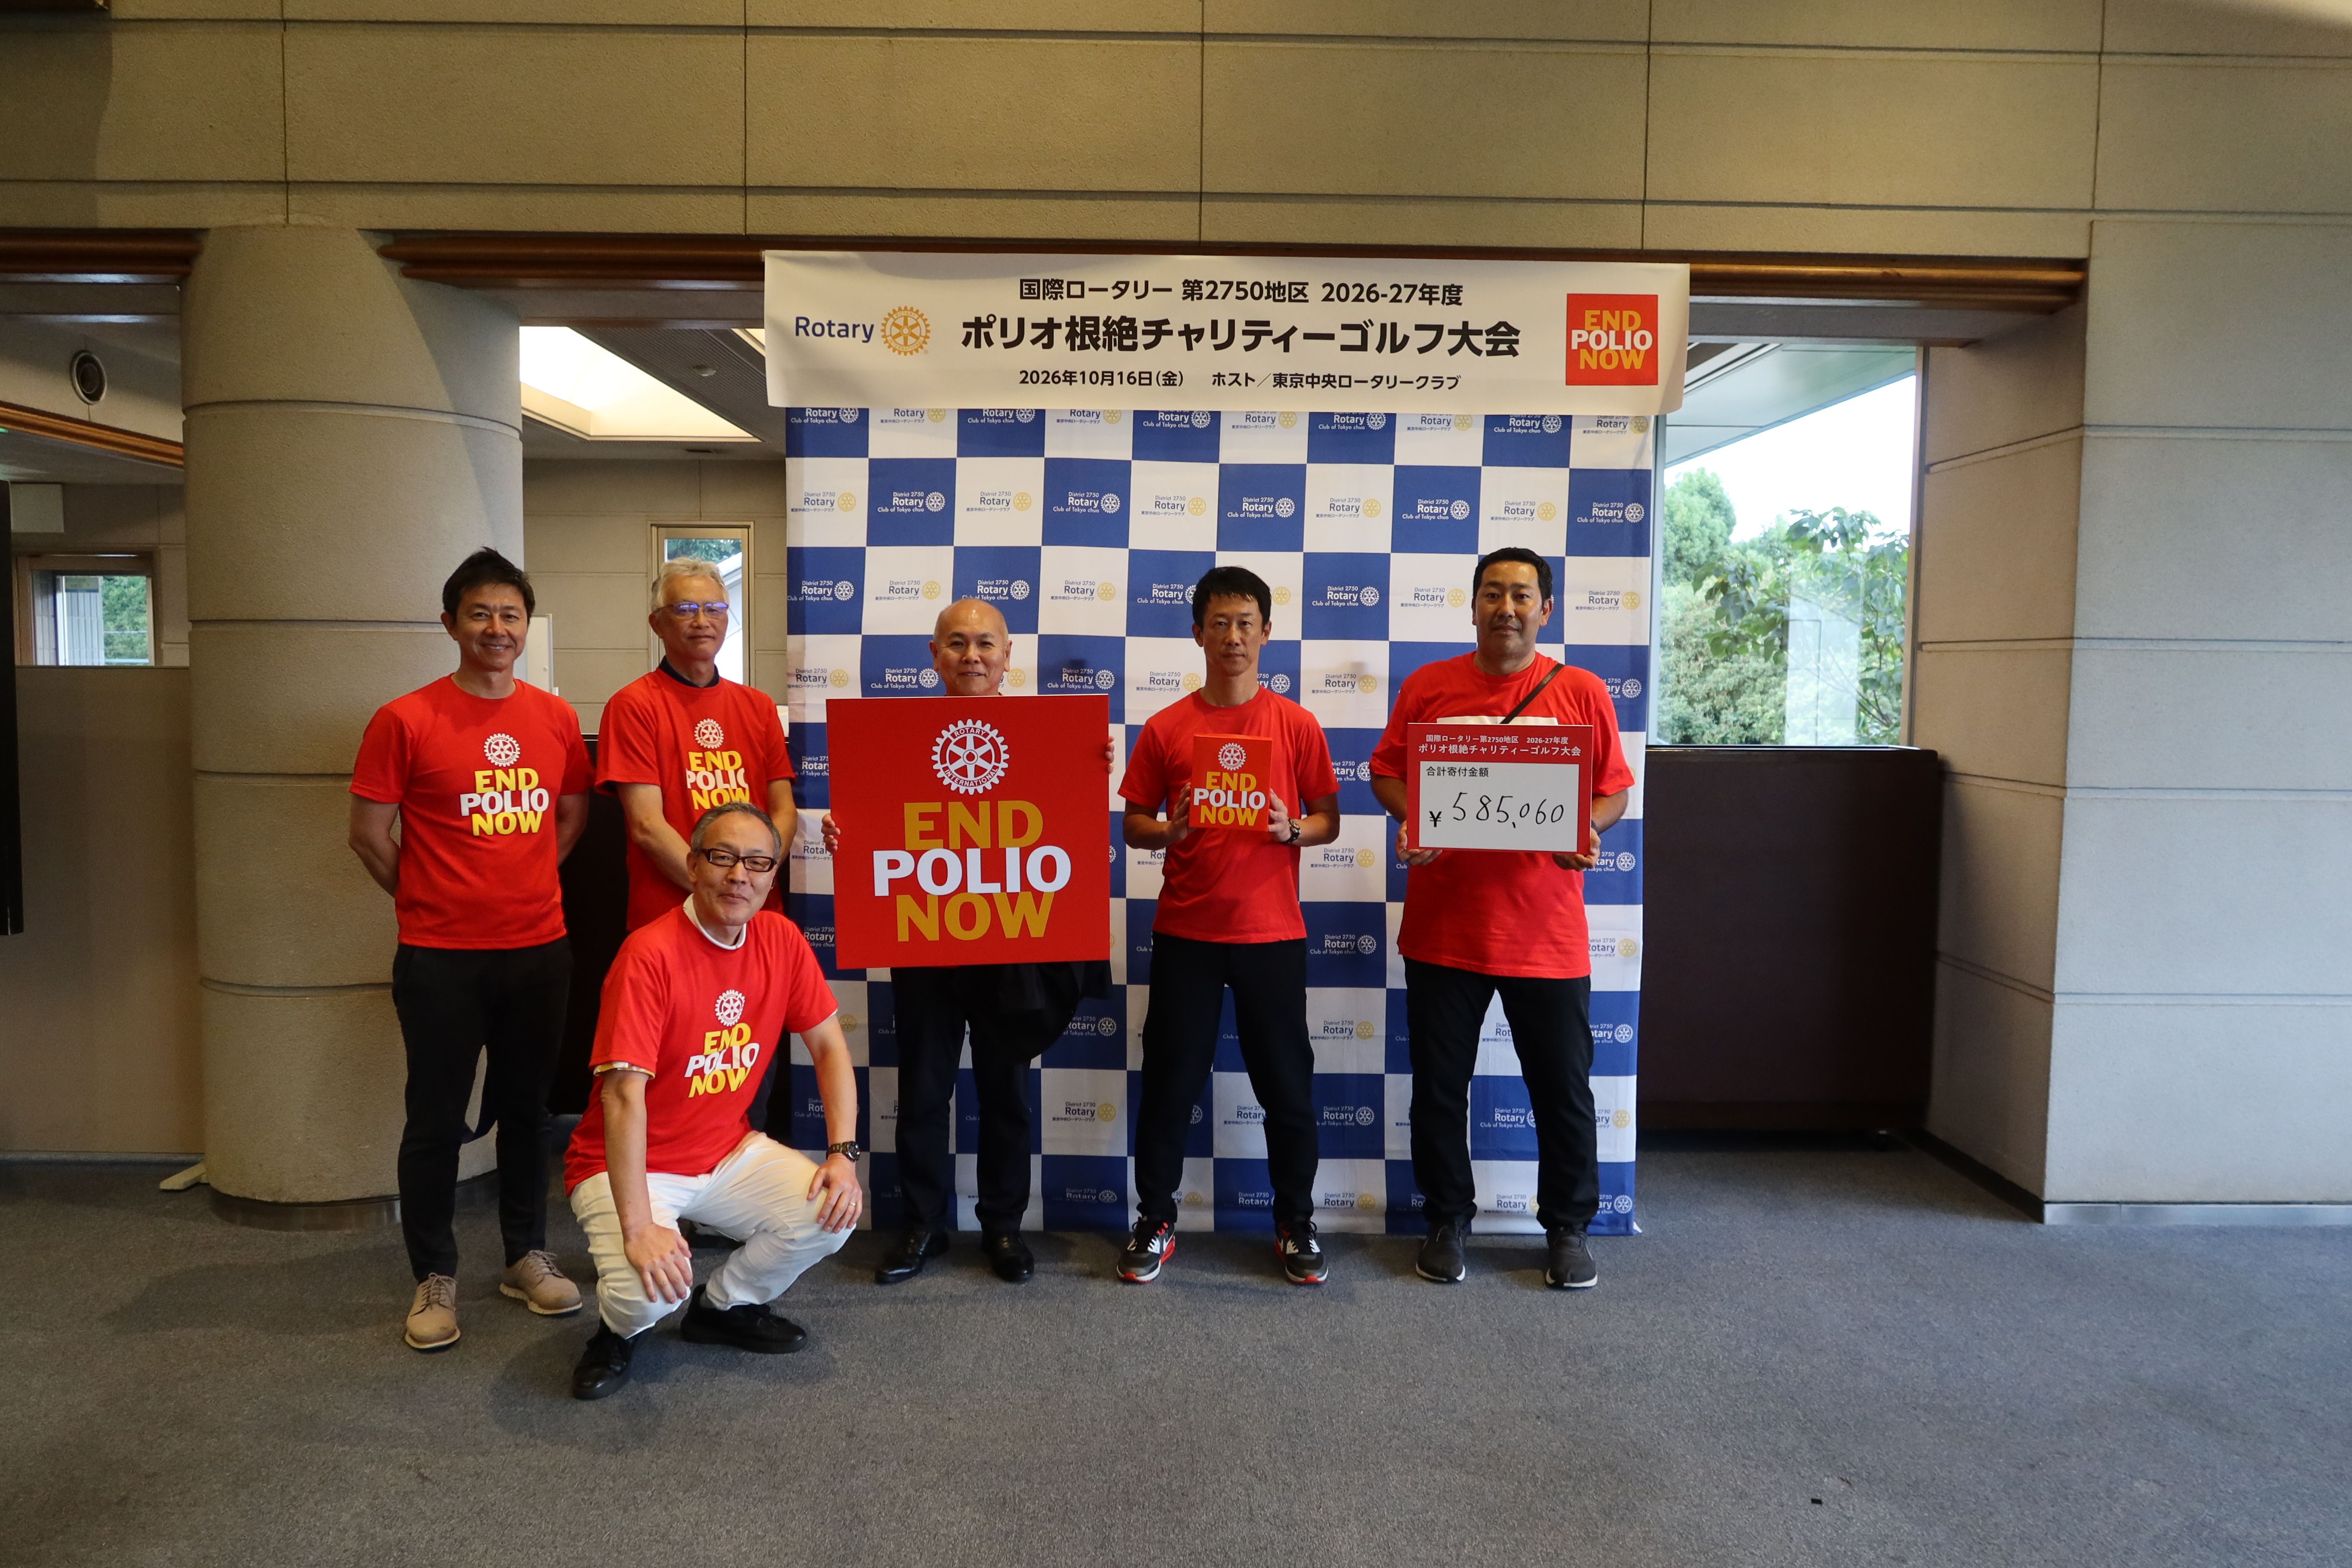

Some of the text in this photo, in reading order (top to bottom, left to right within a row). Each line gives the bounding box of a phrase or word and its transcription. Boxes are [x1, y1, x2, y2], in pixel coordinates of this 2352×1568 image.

[1020, 279, 1464, 306] 国際ロータリー 第2750地区 2026-27年度
[1584, 310, 1642, 331] END
[795, 316, 874, 343] Rotary
[961, 313, 1521, 357] ポリオ根絶チャリティーゴルフ大会
[1571, 329, 1653, 350] POLIO
[1580, 349, 1645, 369] NOW
[894, 408, 924, 418] Rotary
[1158, 413, 1189, 423] Rotary
[1246, 414, 1276, 424] Rotary
[1509, 418, 1540, 428] Rotary
[893, 497, 924, 507] Rotary
[980, 497, 1010, 506] Rotary
[1243, 503, 1274, 513] Rotary
[1329, 503, 1360, 513] Rotary
[1418, 505, 1449, 514] Rotary
[1504, 506, 1534, 516] Rotary
[1592, 508, 1623, 518] Rotary
[889, 586, 919, 595] Rotary
[1152, 589, 1183, 599] Rotary
[1327, 591, 1358, 601] Rotary
[1414, 593, 1444, 602] Rotary
[1589, 596, 1619, 605] Rotary
[886, 674, 917, 684] Rotary
[1325, 679, 1355, 689] Rotary
[954, 727, 986, 737] ROTARY
[1426, 735, 1568, 744] 国際ロータリー第2750地区 2026-27年度
[1418, 743, 1581, 756] ポリオ根絶チャリティーゴルフ大会
[688, 750, 742, 772] END
[1426, 766, 1489, 778] 合計寄付金額
[475, 768, 539, 793] END
[945, 768, 998, 787] INTERNATIONAL
[1206, 771, 1256, 792] END
[460, 788, 549, 816] POLIO
[691, 787, 750, 810] NOW
[1193, 788, 1265, 809] POLIO
[1452, 792, 1564, 828] 585,060
[1200, 805, 1259, 826] NOW
[472, 810, 542, 836] NOW
[903, 800, 1043, 851] END
[1324, 854, 1354, 863] Rotary
[873, 845, 1072, 897] POLIO
[896, 891, 1055, 942] NOW
[1325, 940, 1356, 949] Rotary
[1324, 1026, 1353, 1035] Rotary
[703, 1023, 751, 1056] END
[684, 1043, 760, 1078] POLIO
[688, 1066, 751, 1098] NOW
[1066, 1107, 1095, 1116] Rotary
[1495, 1114, 1525, 1123] Rotary
[1238, 1197, 1269, 1206] Rotary
[1497, 1200, 1526, 1209] Rotary
